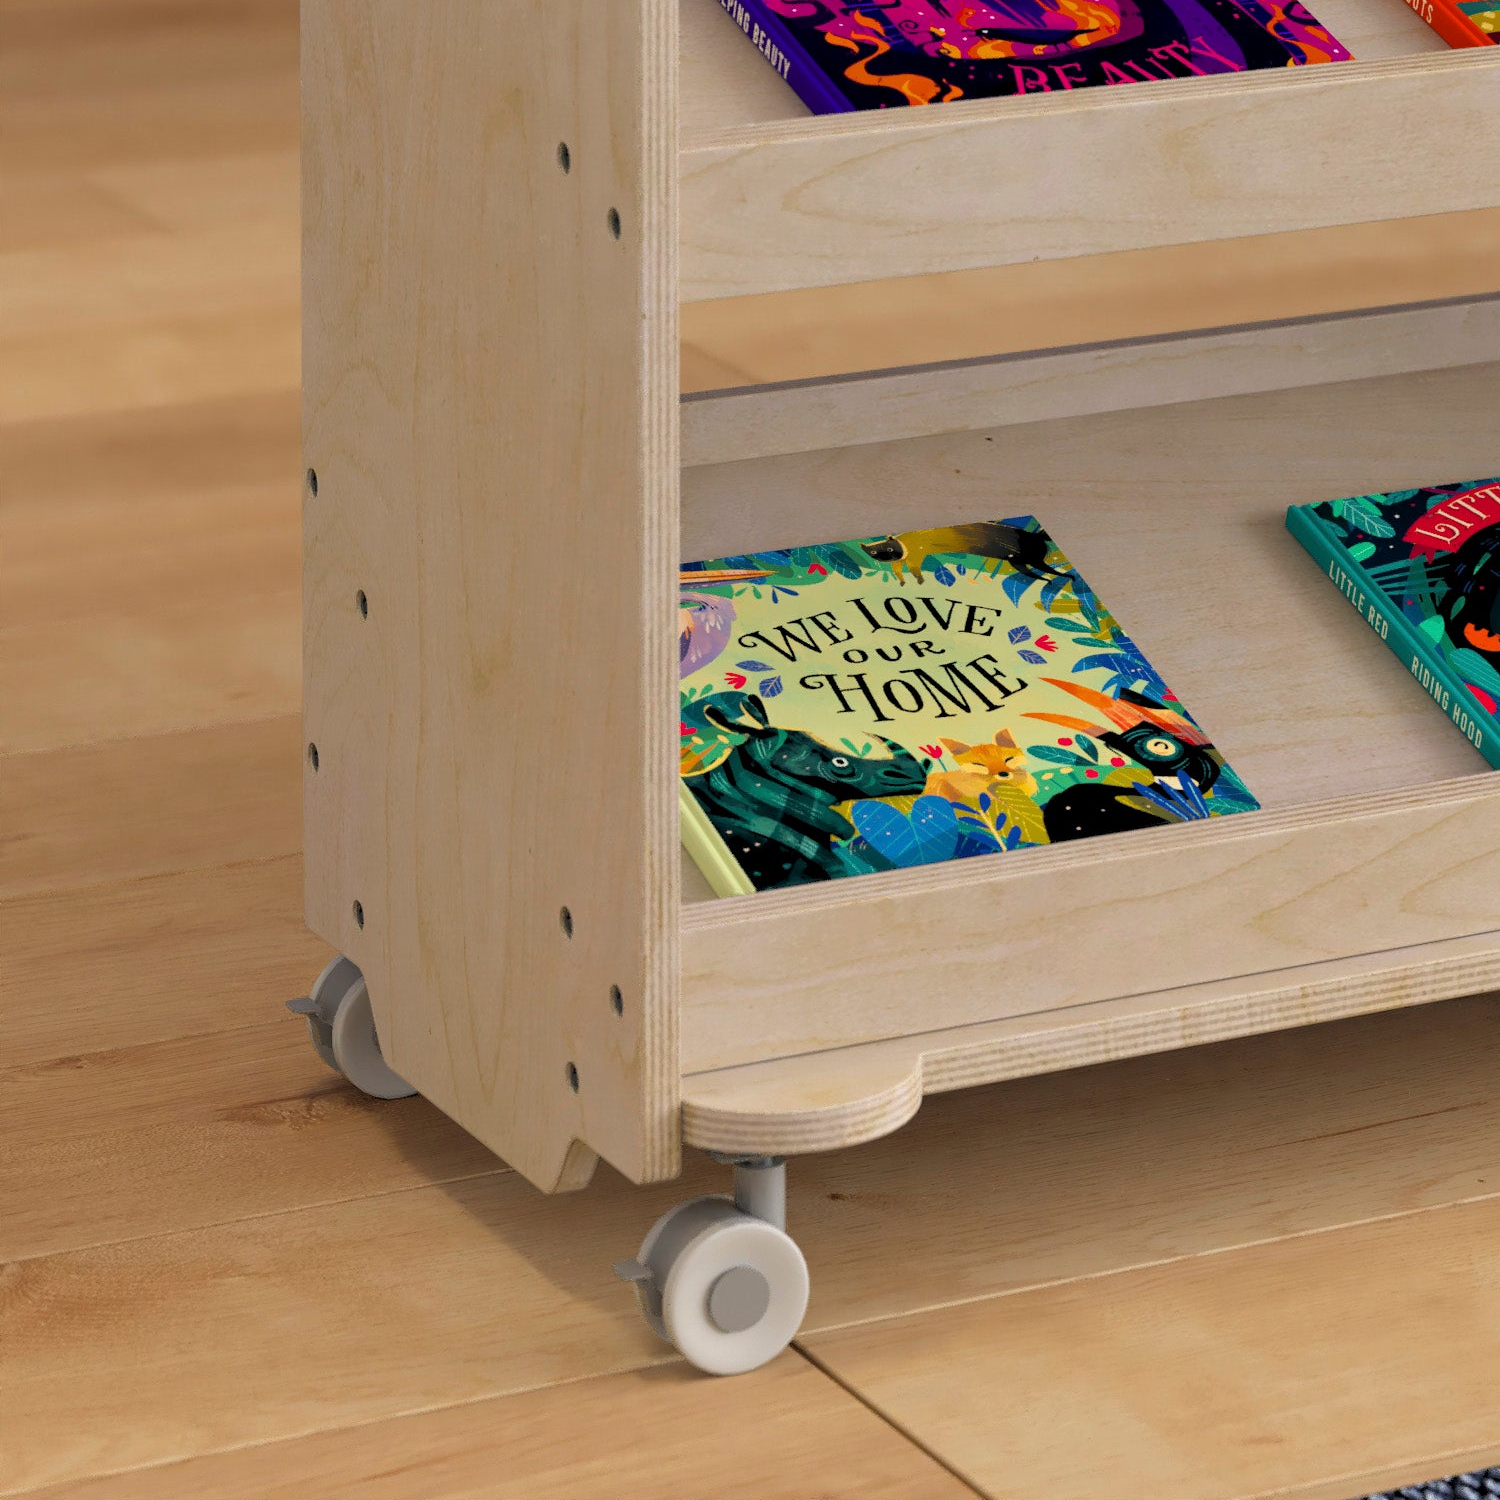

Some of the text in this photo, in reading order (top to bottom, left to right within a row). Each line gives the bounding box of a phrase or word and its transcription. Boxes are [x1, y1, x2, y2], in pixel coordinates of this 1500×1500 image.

[752, 23, 790, 79] BEAUTY
[738, 597, 1002, 662] WE LOVE
[842, 640, 946, 664] OUR
[1329, 560, 1483, 749] LITTLE RED RIDING HOOD
[800, 654, 1028, 722] HOME
